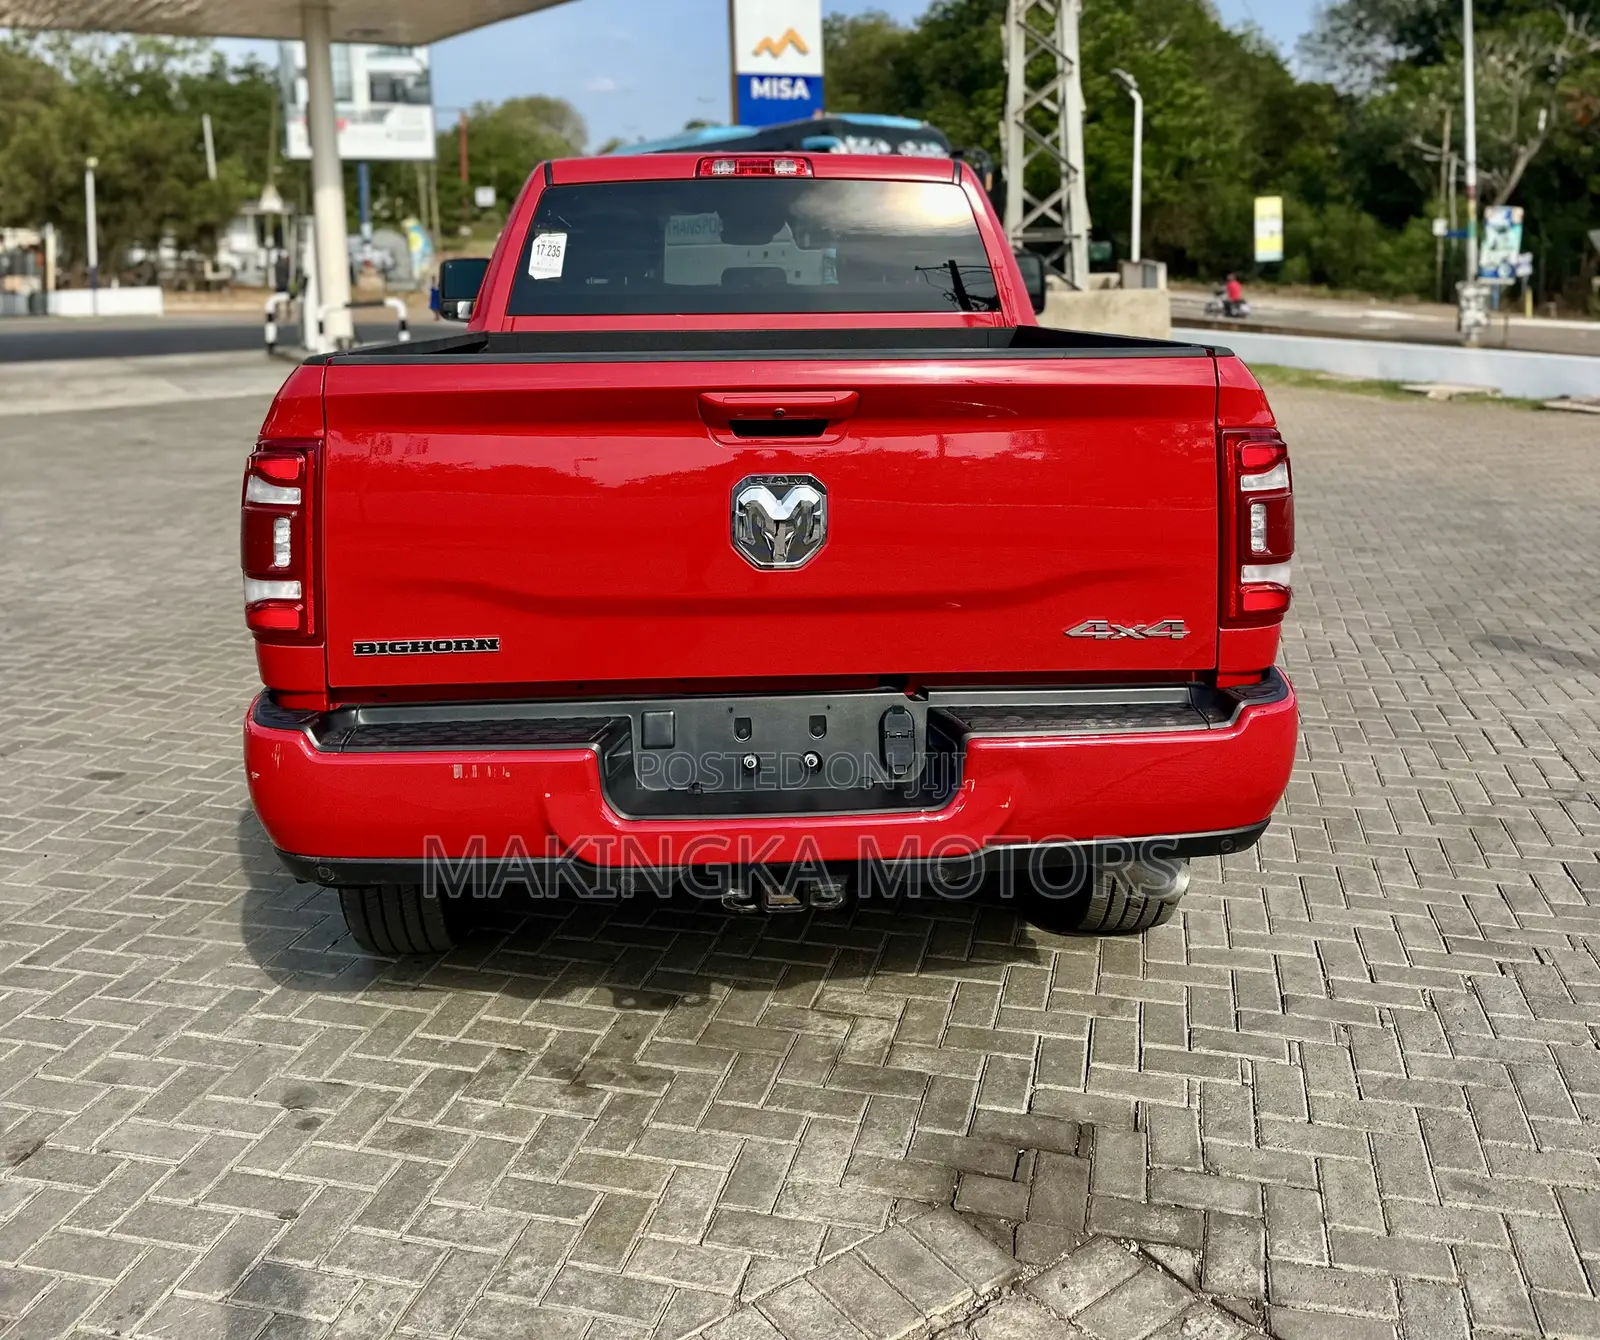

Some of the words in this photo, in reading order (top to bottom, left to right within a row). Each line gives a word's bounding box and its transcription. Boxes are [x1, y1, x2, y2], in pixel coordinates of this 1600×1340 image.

[751, 77, 810, 100] MISA
[750, 475, 808, 485] RAM
[1064, 619, 1191, 640] 4x4
[353, 637, 500, 656] BIGHORN
